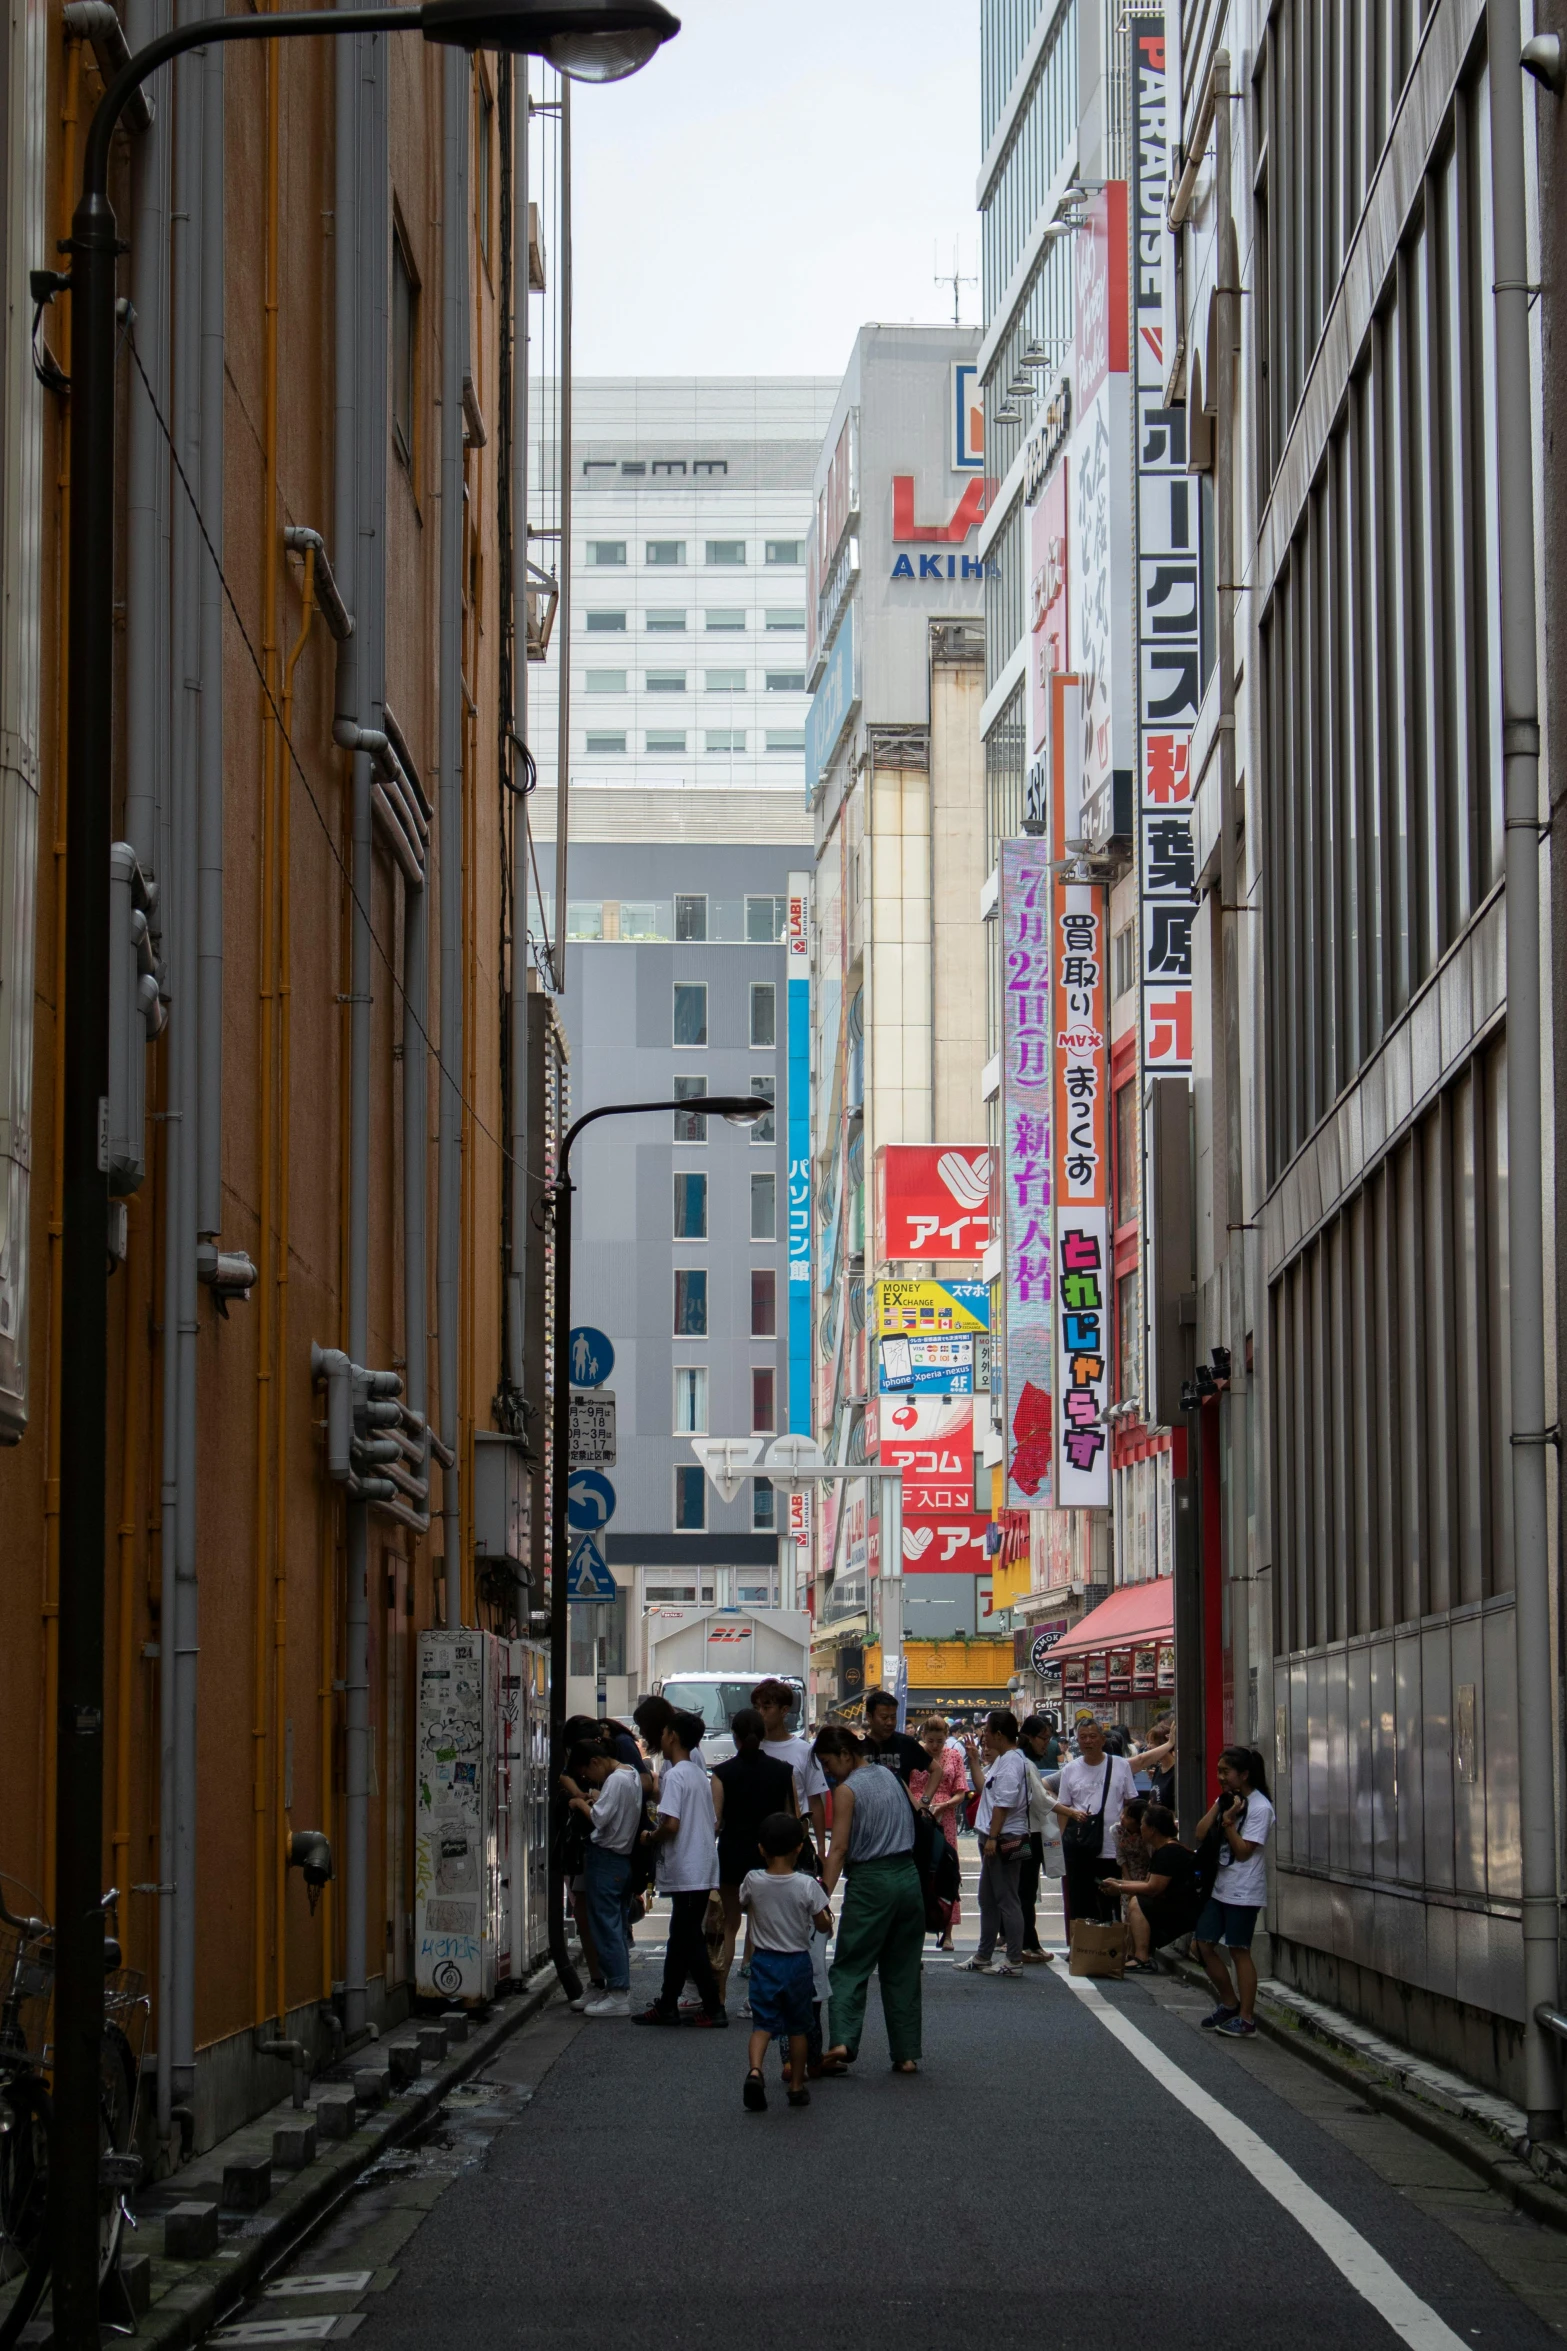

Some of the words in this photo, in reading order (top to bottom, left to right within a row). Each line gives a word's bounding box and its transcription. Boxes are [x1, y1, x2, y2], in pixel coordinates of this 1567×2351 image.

[1139, 36, 1166, 309] PARADISE
[790, 896, 802, 936] LABI
[1062, 914, 1096, 1016] 買取り
[1059, 1034, 1101, 1048] MAX
[1066, 1065, 1096, 1186] まっくす
[788, 1158, 810, 1282] パソコン館
[883, 1283, 921, 1293] MONEY
[1060, 1229, 1105, 1473] とれじゃらす
[950, 1375, 968, 1388] 4F
[891, 1450, 962, 1474] アコム
[917, 1490, 951, 1507] 入口
[455, 1646, 473, 1660] 324
[1035, 1699, 1062, 1711] Coffee
